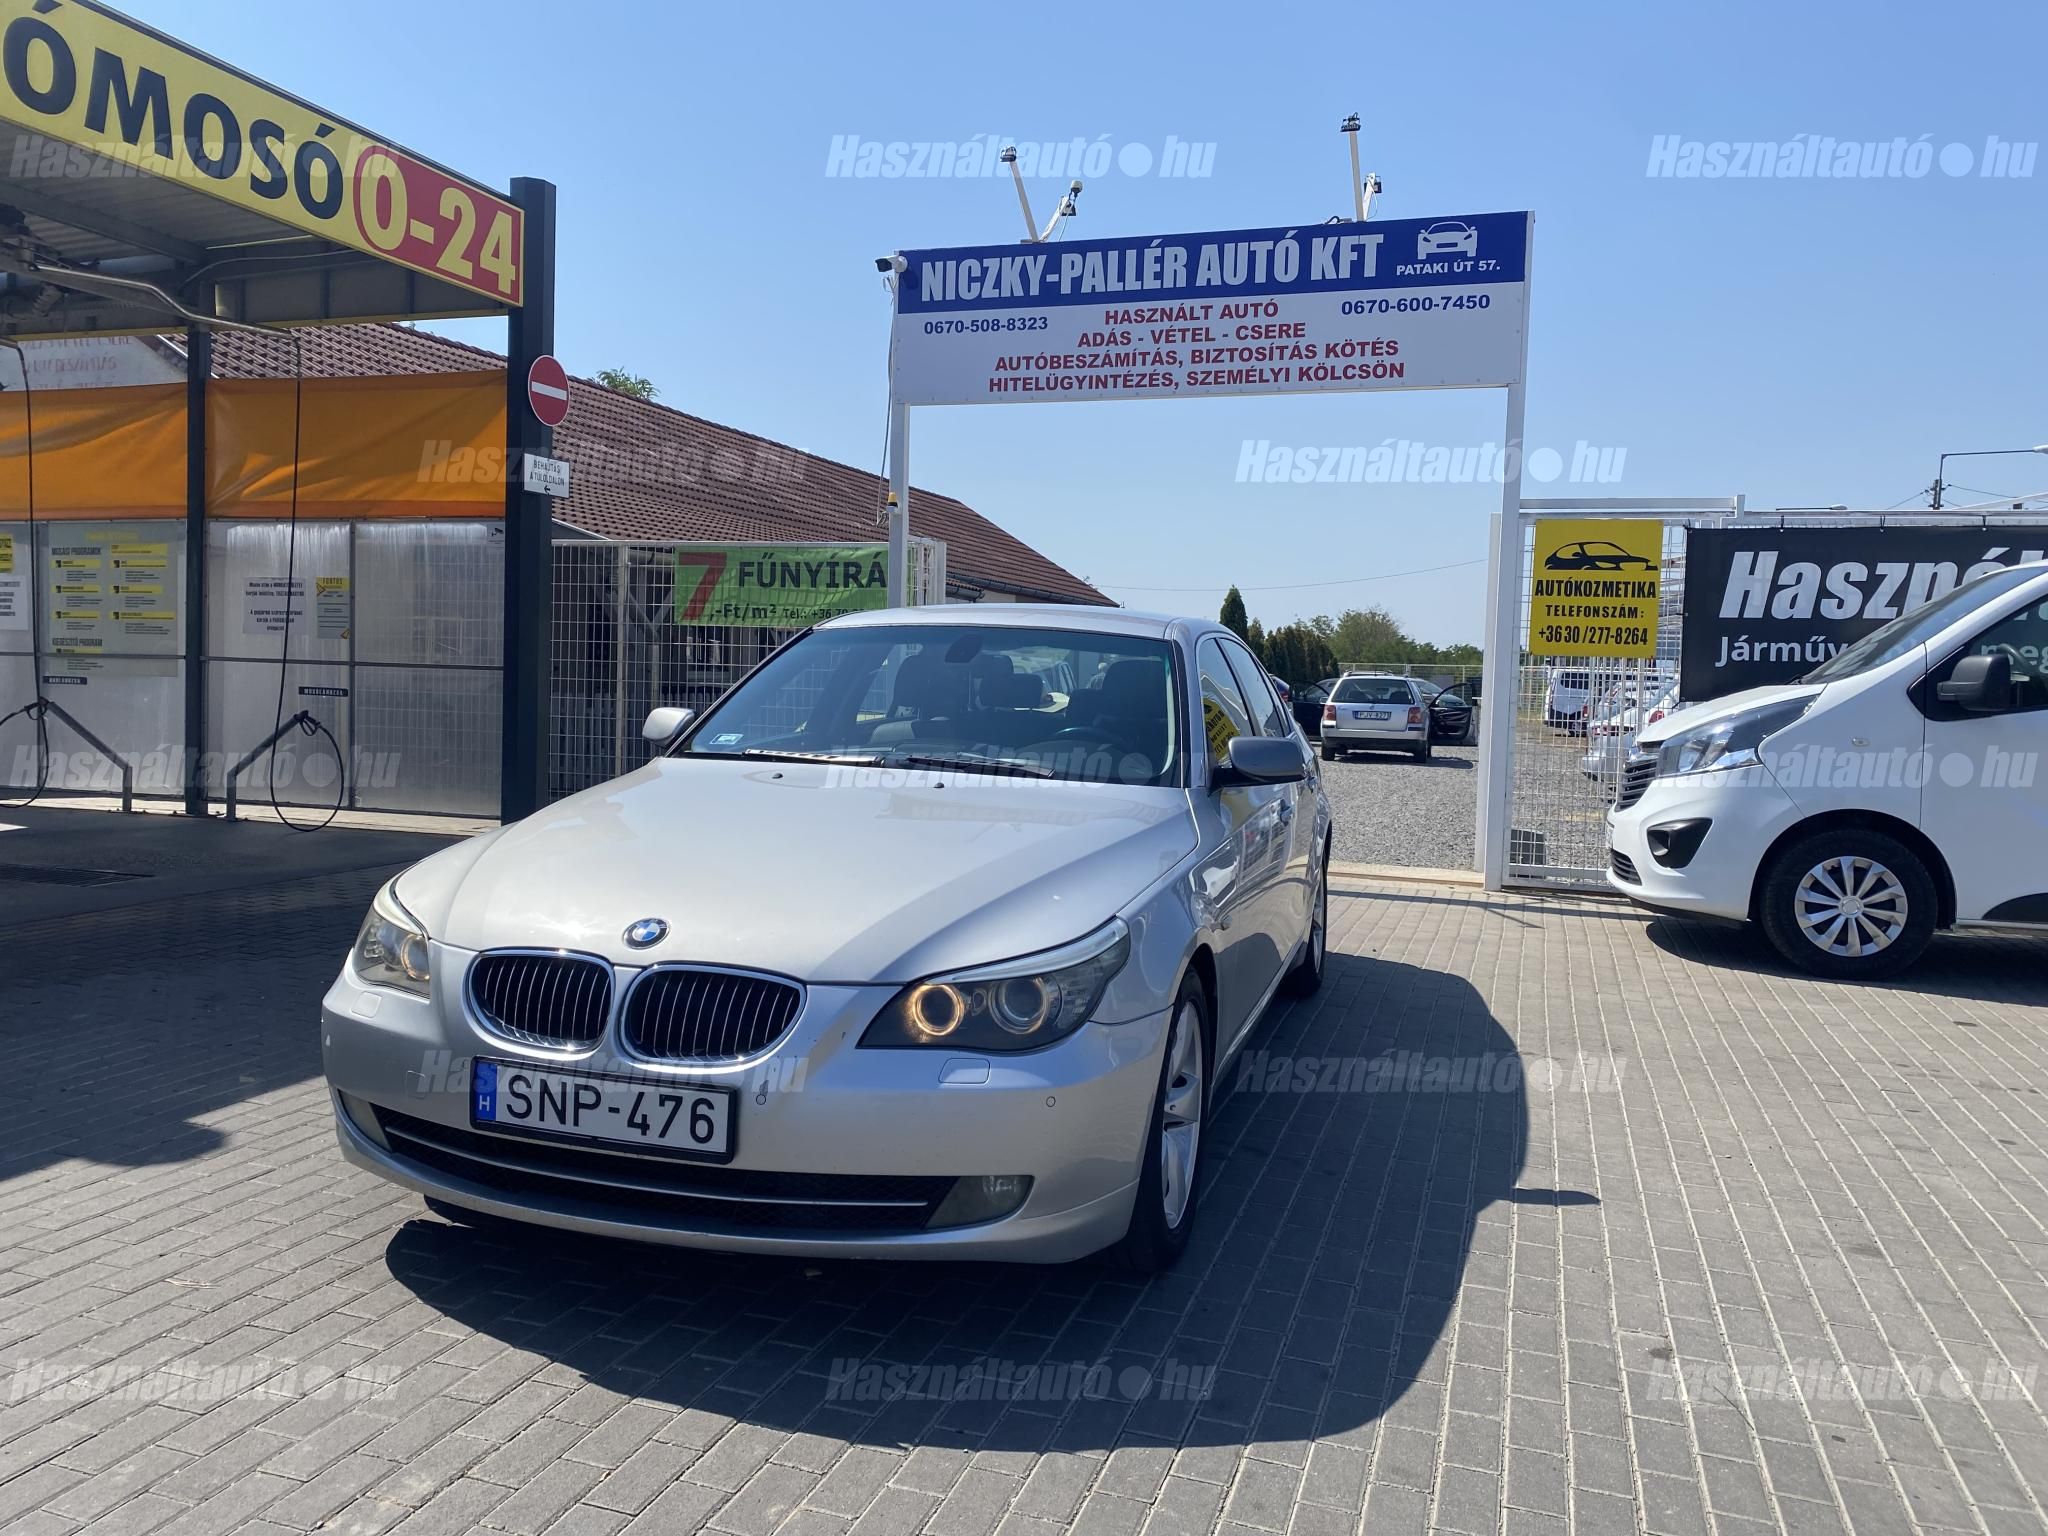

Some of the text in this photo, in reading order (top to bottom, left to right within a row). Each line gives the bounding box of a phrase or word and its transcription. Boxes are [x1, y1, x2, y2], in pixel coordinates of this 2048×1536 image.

[359, 152, 516, 295] 0-24
[921, 230, 1384, 302] NICZKY-PALLÉR AUTÓ KFT
[1396, 259, 1500, 276] PATAKI ÚT 57.
[1105, 299, 1279, 325] HASZNÁLT AUTÓ
[1341, 294, 1491, 315] 0670-600-7450
[924, 317, 1048, 335] 0670-508-8323
[1078, 329, 1132, 348] ADÁS
[1150, 327, 1216, 345] VÉTEL
[1235, 322, 1306, 340] CSERE
[995, 337, 1399, 371] AUTÓBESZÁMÍTÁS, BIZTOSÍTÁS KÖTÉS
[989, 361, 1405, 393] HITELÜGYINTÉZÉS, SZEMÉLYI KÖLCSÖN
[1535, 577, 1656, 598] AUTÓKOZMETIKA
[478, 1074, 715, 1144] H SNP-476
